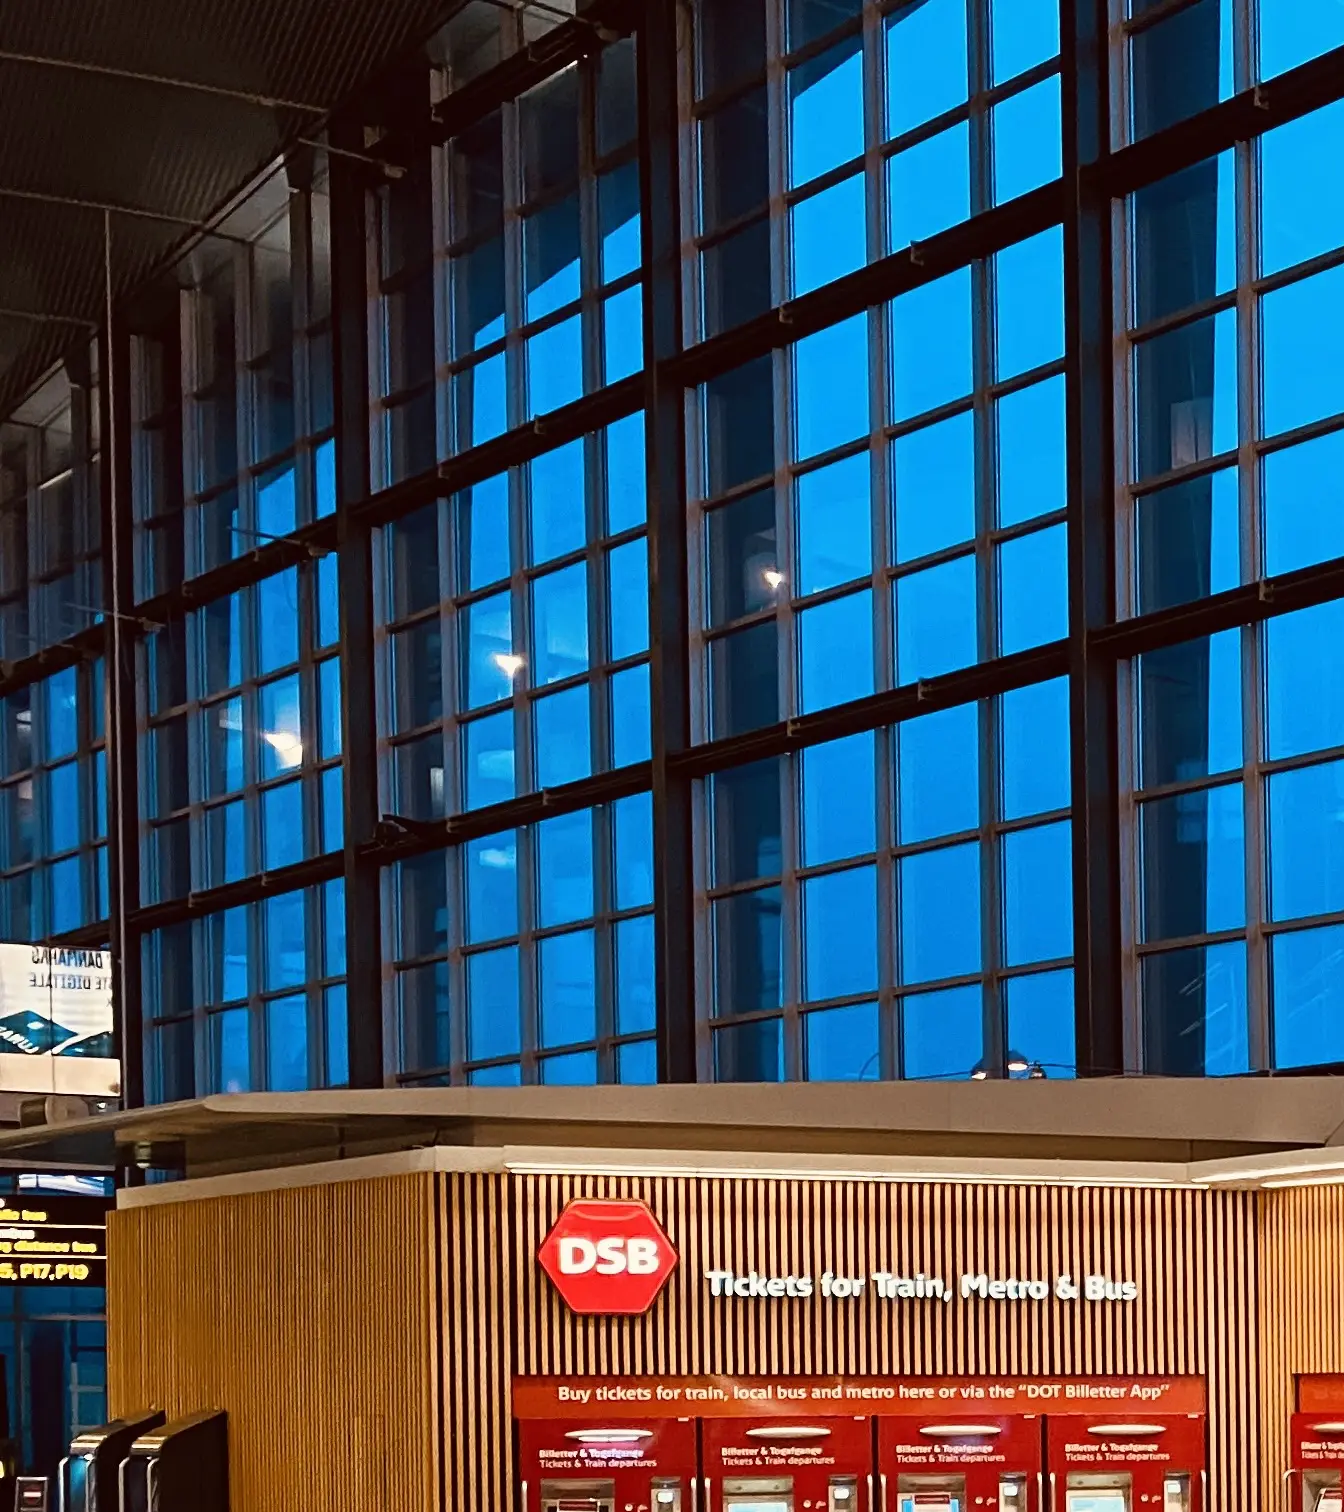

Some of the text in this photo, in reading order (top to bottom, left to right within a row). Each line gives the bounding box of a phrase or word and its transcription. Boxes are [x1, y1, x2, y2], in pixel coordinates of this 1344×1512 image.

[557, 1237, 659, 1275] DSB
[705, 1270, 1137, 1303] Tickets for Train, Metro & Bus
[558, 1386, 591, 1404] Buy
[595, 1385, 652, 1400] tickets
[655, 1385, 682, 1400] for
[685, 1386, 729, 1402] train,
[733, 1384, 772, 1400] local
[776, 1385, 807, 1400] bus
[811, 1385, 843, 1400] and
[846, 1386, 895, 1400] metro
[898, 1384, 935, 1400] here
[938, 1388, 958, 1399] or
[960, 1385, 985, 1399] via
[988, 1385, 1016, 1399] the
[1065, 1385, 1128, 1399] Billetter
